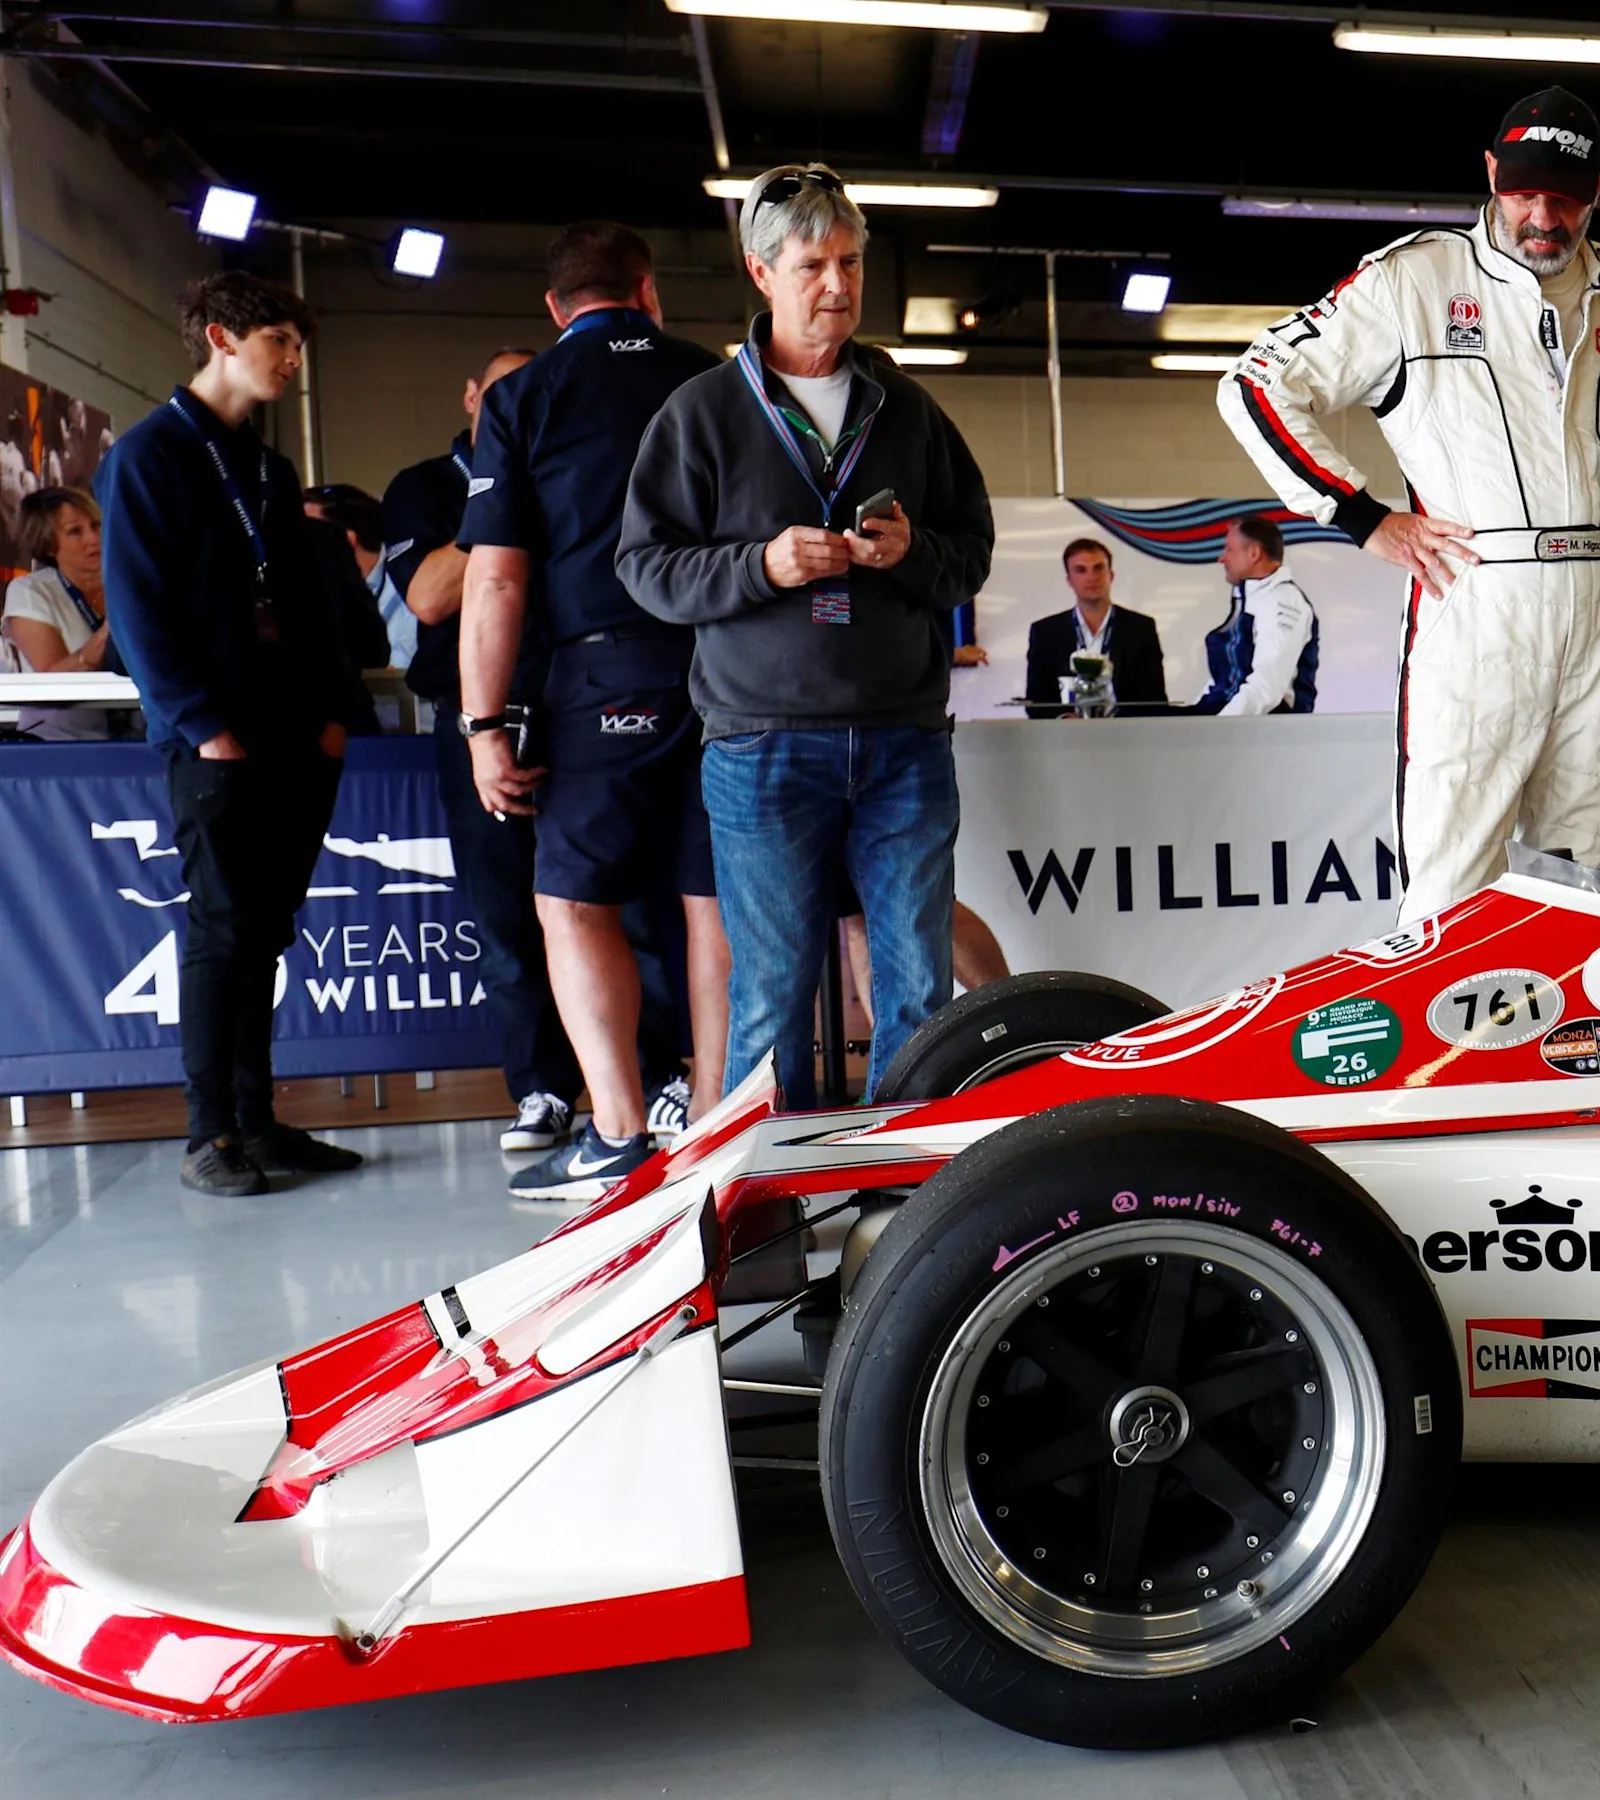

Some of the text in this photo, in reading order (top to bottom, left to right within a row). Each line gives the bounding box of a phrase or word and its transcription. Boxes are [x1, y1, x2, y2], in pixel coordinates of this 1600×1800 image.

[1519, 126, 1593, 154] AVON
[1560, 144, 1588, 159] TYRES
[302, 920, 482, 968] YEARS
[1471, 970, 1531, 983] GOODWOOD
[1329, 1000, 1376, 1013] GRAND PRIX
[1329, 1005, 1374, 1018] HISTORIQUE
[1453, 983, 1541, 1031] 761
[1330, 1012, 1364, 1022] MONACO
[1301, 1019, 1390, 1059] F
[1457, 1025, 1547, 1049] FESTIVAL OF SPEED
[1553, 1030, 1593, 1043] MONZA
[1087, 1045, 1146, 1061] VUE
[1543, 1042, 1596, 1055] VERIFICATO
[1332, 1052, 1368, 1074] 26
[1325, 1068, 1377, 1085] SERIE
[1057, 1210, 1082, 1230] LF
